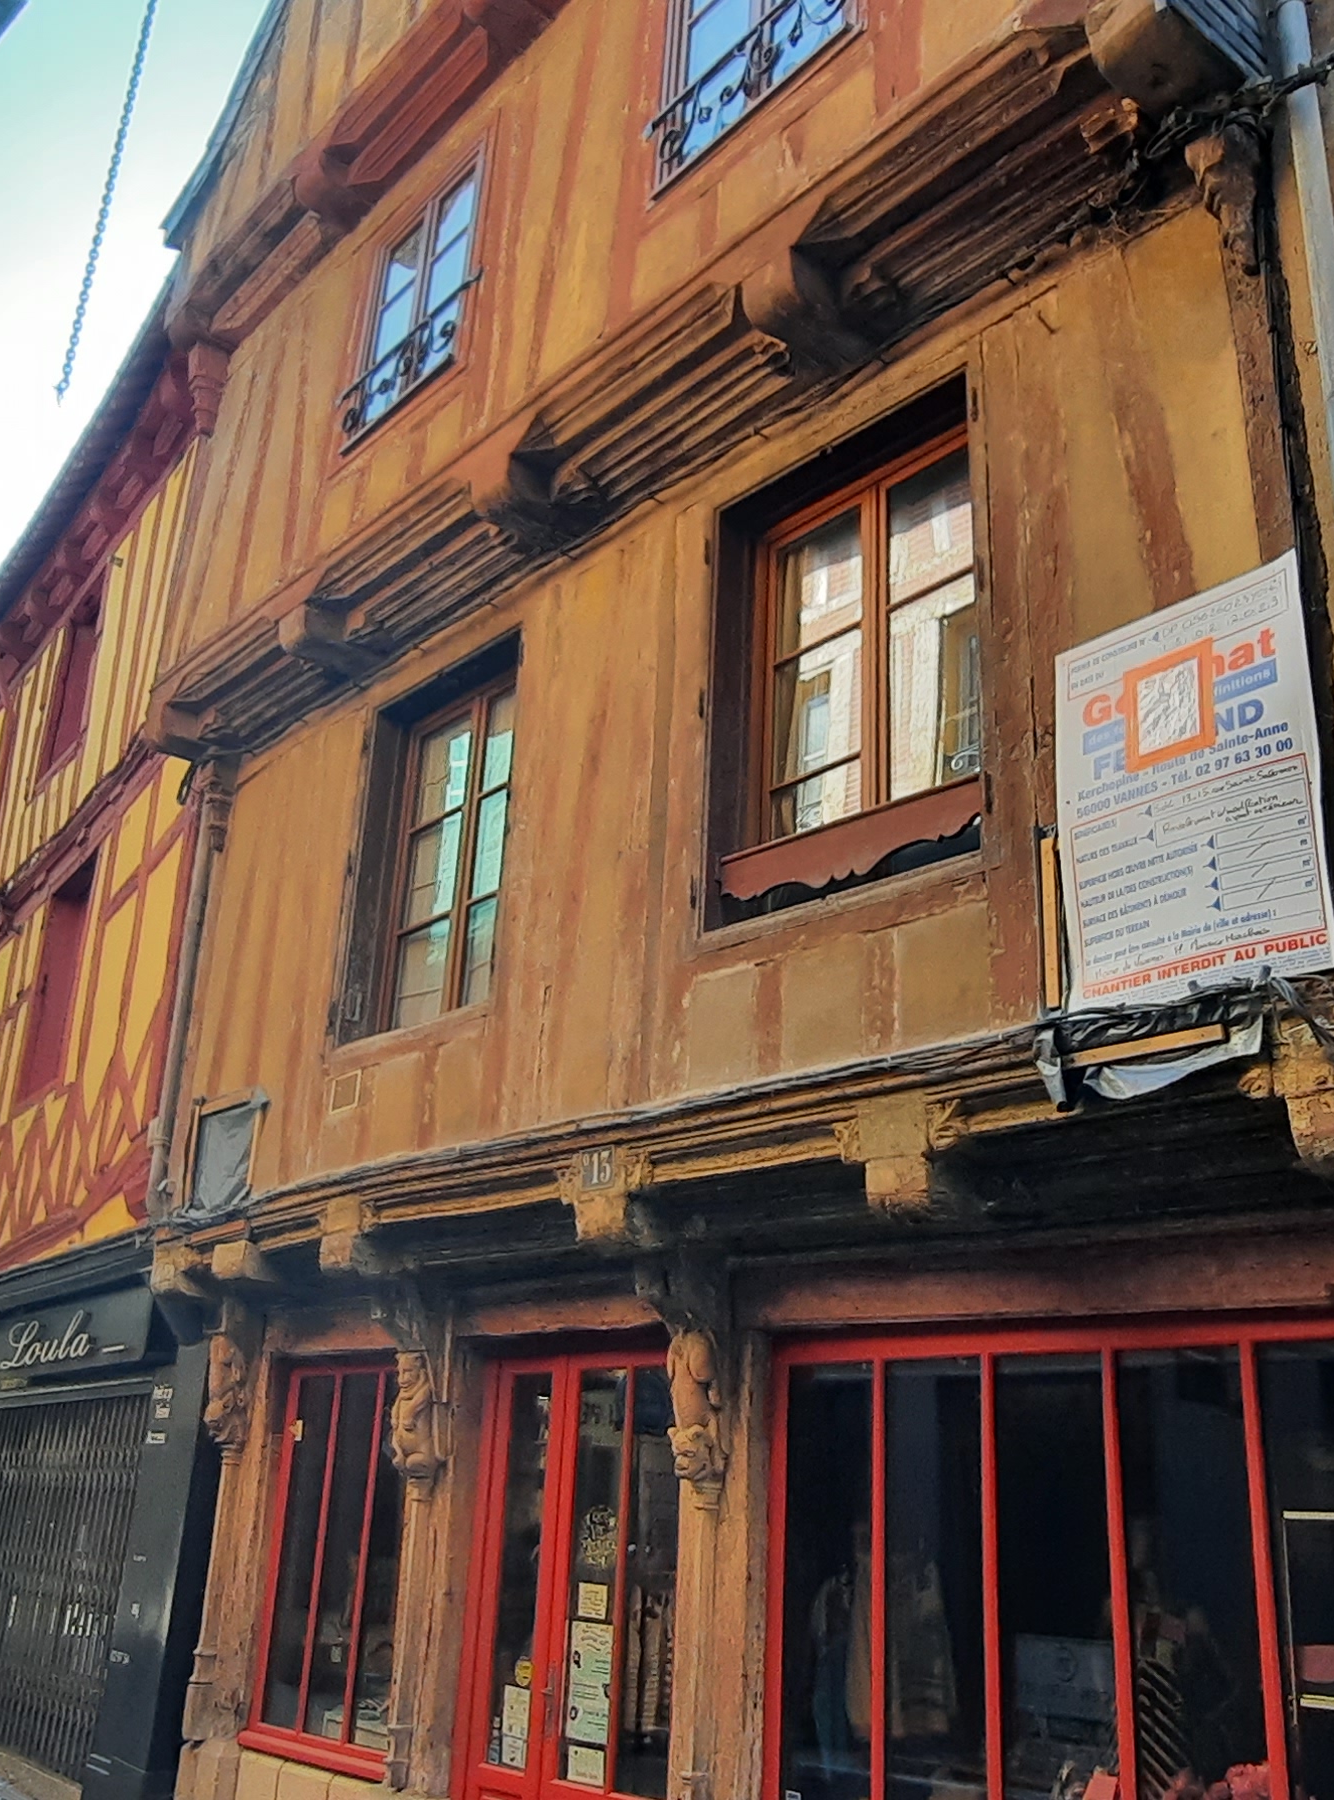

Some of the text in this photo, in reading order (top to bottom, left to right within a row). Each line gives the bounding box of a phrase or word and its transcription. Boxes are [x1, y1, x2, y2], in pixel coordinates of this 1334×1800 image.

[1076, 797, 1111, 819] 56000
[1113, 780, 1159, 805] VANNES
[1195, 763, 1211, 777] 02
[1214, 756, 1229, 771] 97
[1234, 749, 1251, 764] 63
[1255, 743, 1272, 758] 30
[1275, 737, 1294, 752] 00
[1082, 972, 1152, 1000] CHANTIER
[1157, 953, 1227, 981] INTERDIT
[1233, 947, 1257, 963] AU
[1264, 932, 1328, 957] PUBLIC
[0, 1308, 92, 1370] Loula
